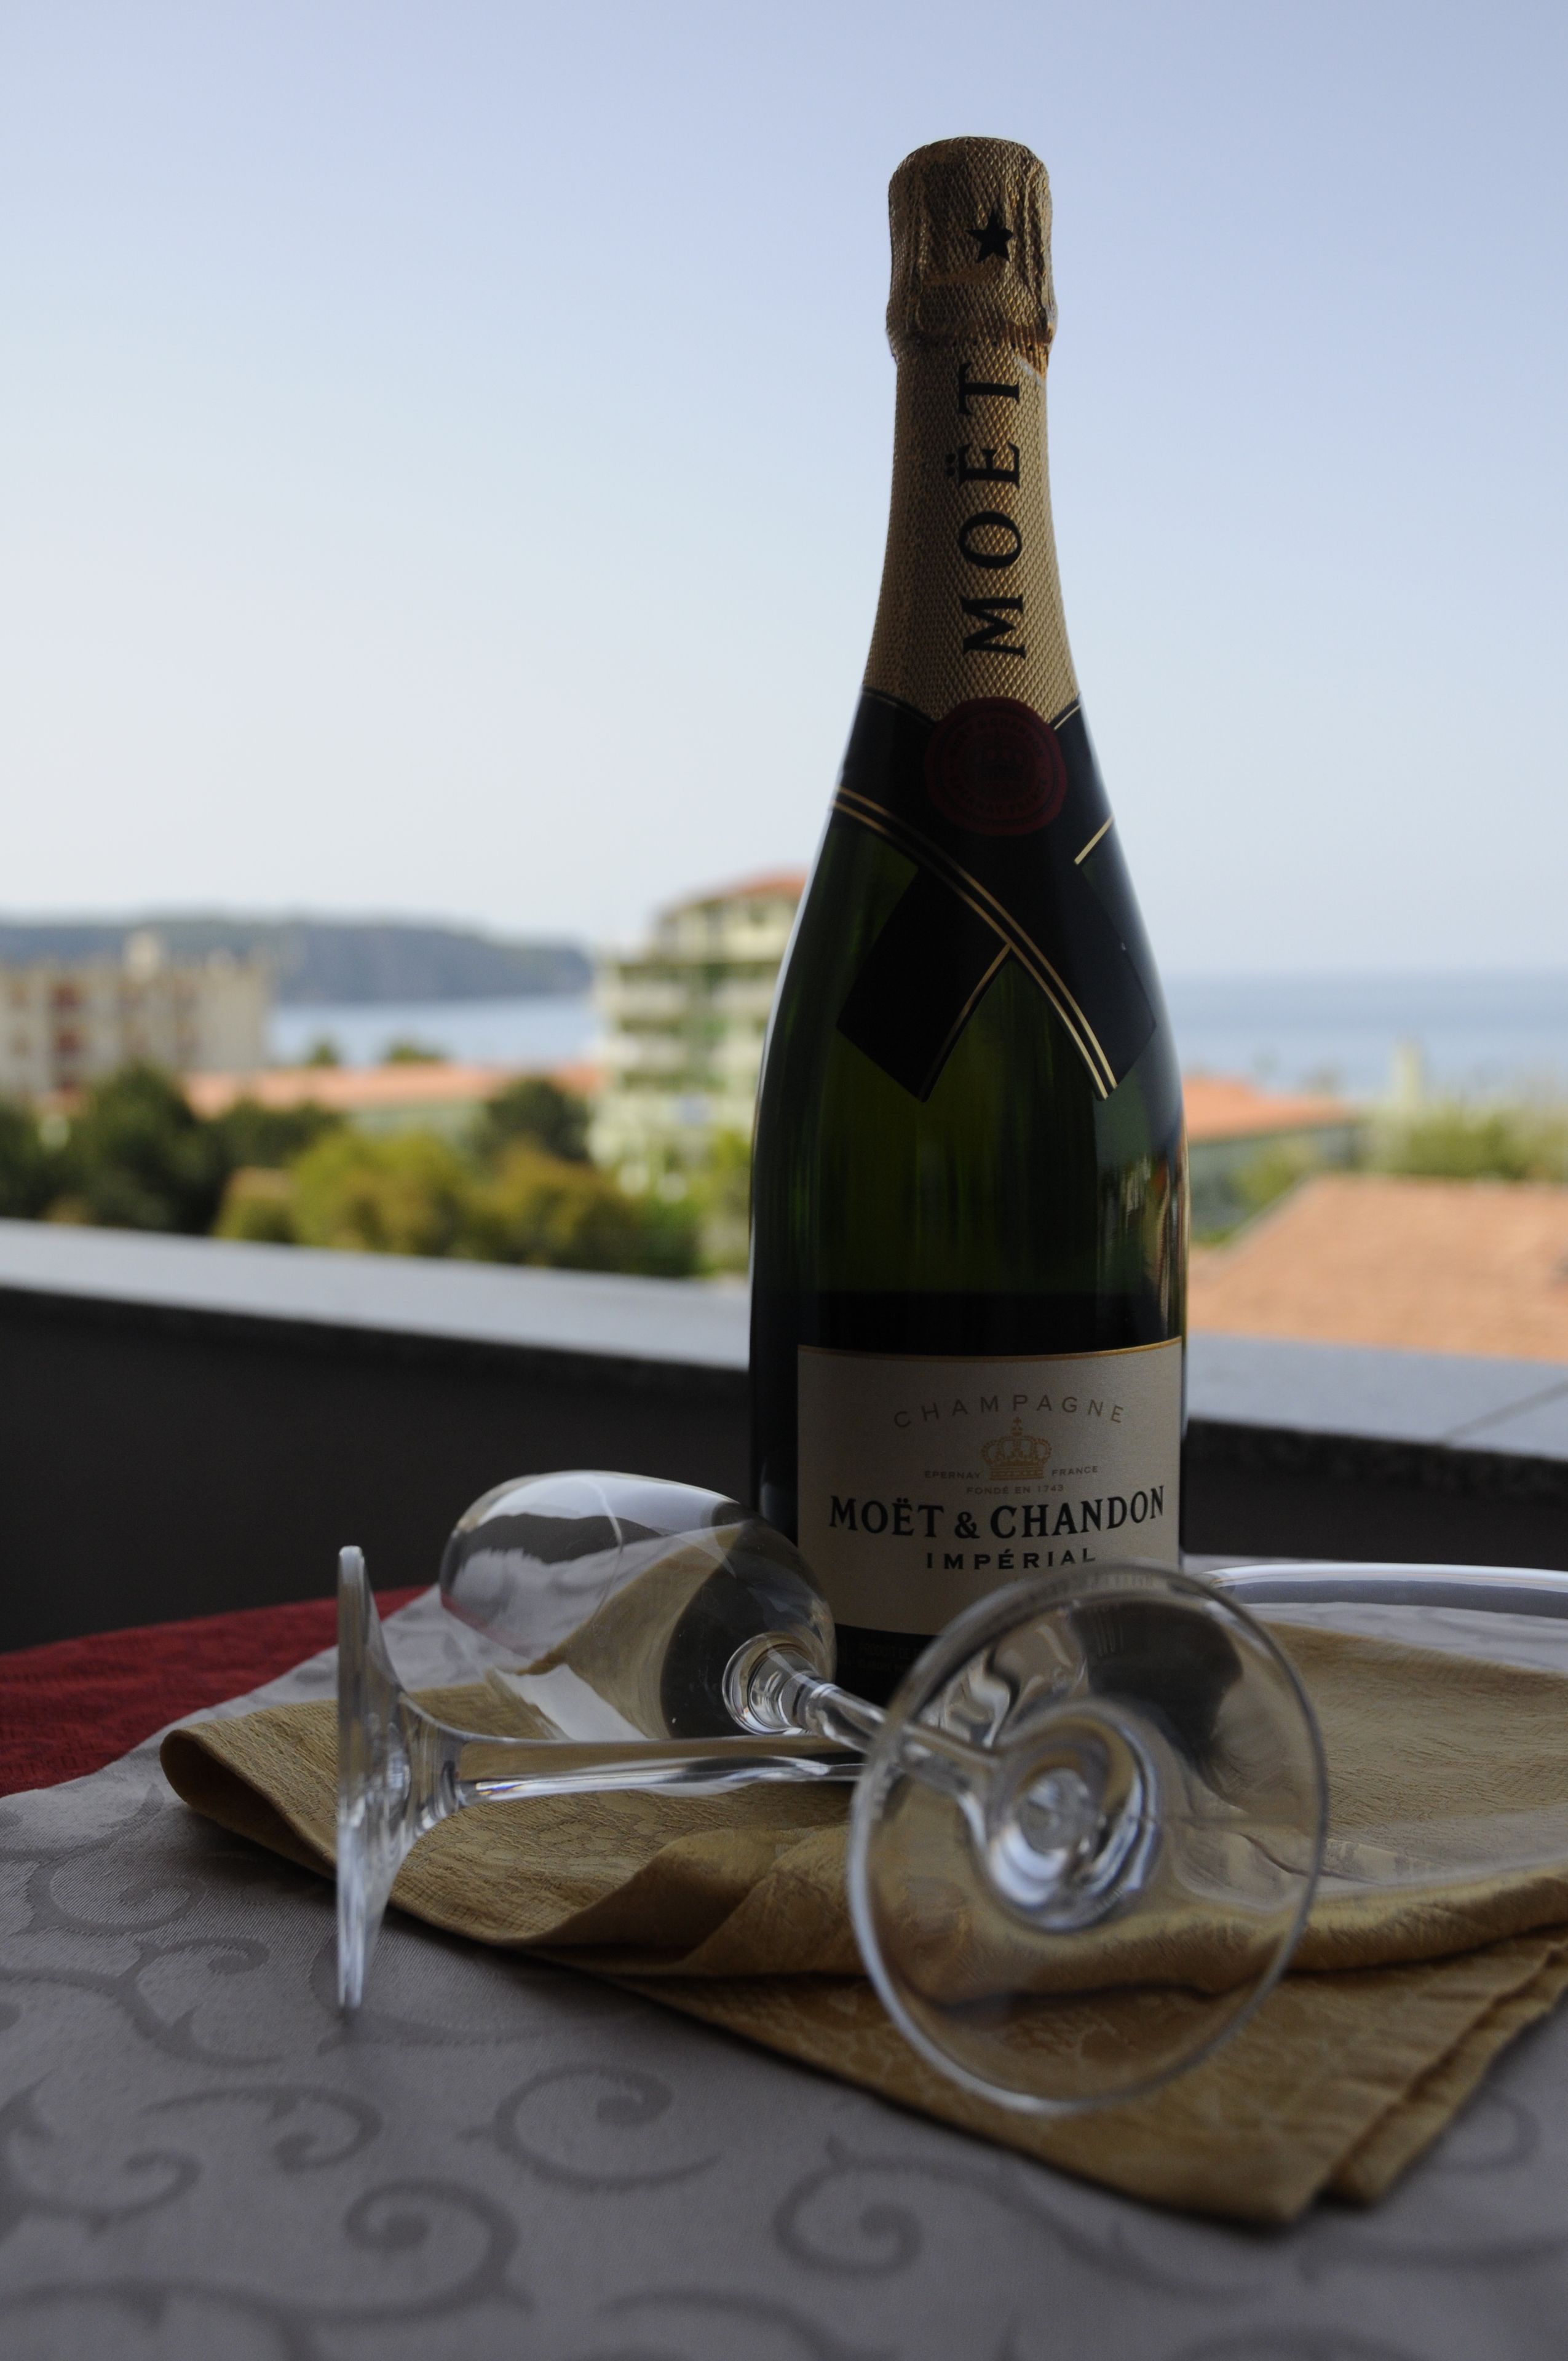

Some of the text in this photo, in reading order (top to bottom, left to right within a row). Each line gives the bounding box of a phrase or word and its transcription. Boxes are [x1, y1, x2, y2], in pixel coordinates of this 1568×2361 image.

[946, 365, 1025, 658] MOËT
[894, 1394, 1124, 1428] CHAMPAGNE
[1051, 1466, 1098, 1476] FRANCE
[966, 1485, 1009, 1495] FONDÉ
[829, 1485, 1165, 1538] MOËT & CHANDON
[927, 1548, 1096, 1570] IMPÉRIAL
